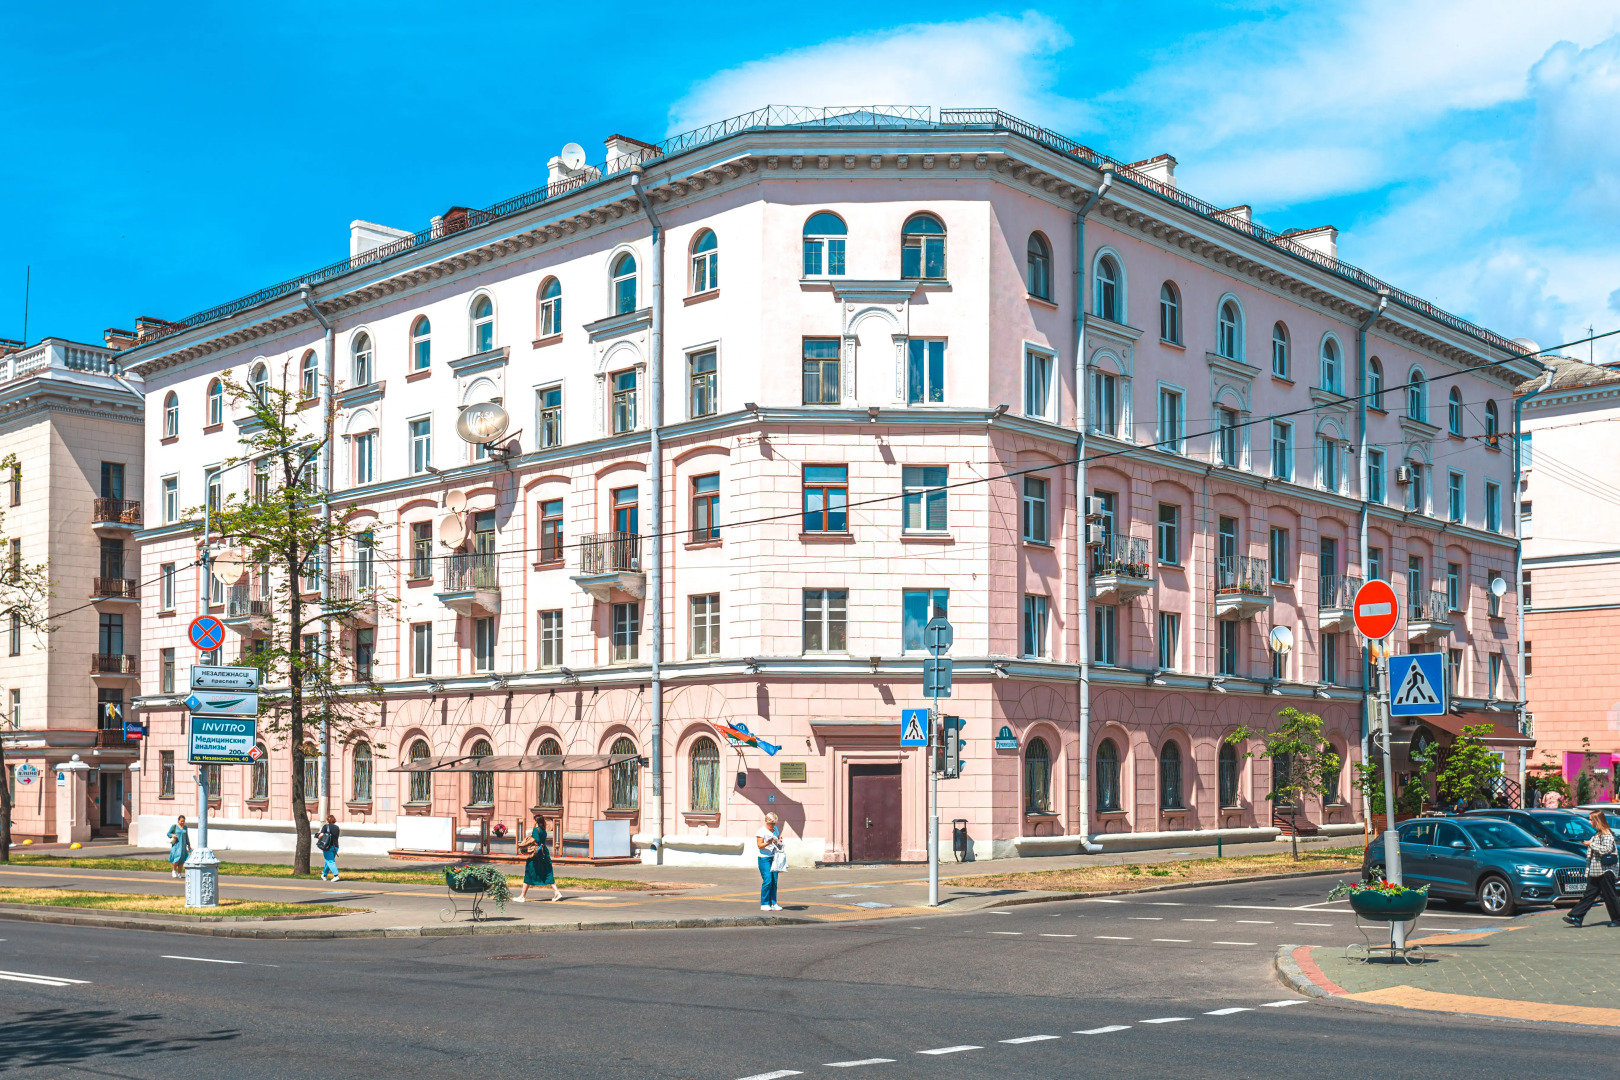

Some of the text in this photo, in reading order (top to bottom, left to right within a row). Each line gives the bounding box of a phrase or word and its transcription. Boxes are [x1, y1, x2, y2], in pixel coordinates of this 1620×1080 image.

[202, 722, 245, 732] INVITRO
[1002, 728, 1008, 737] 11
[195, 735, 247, 744] Медицинские
